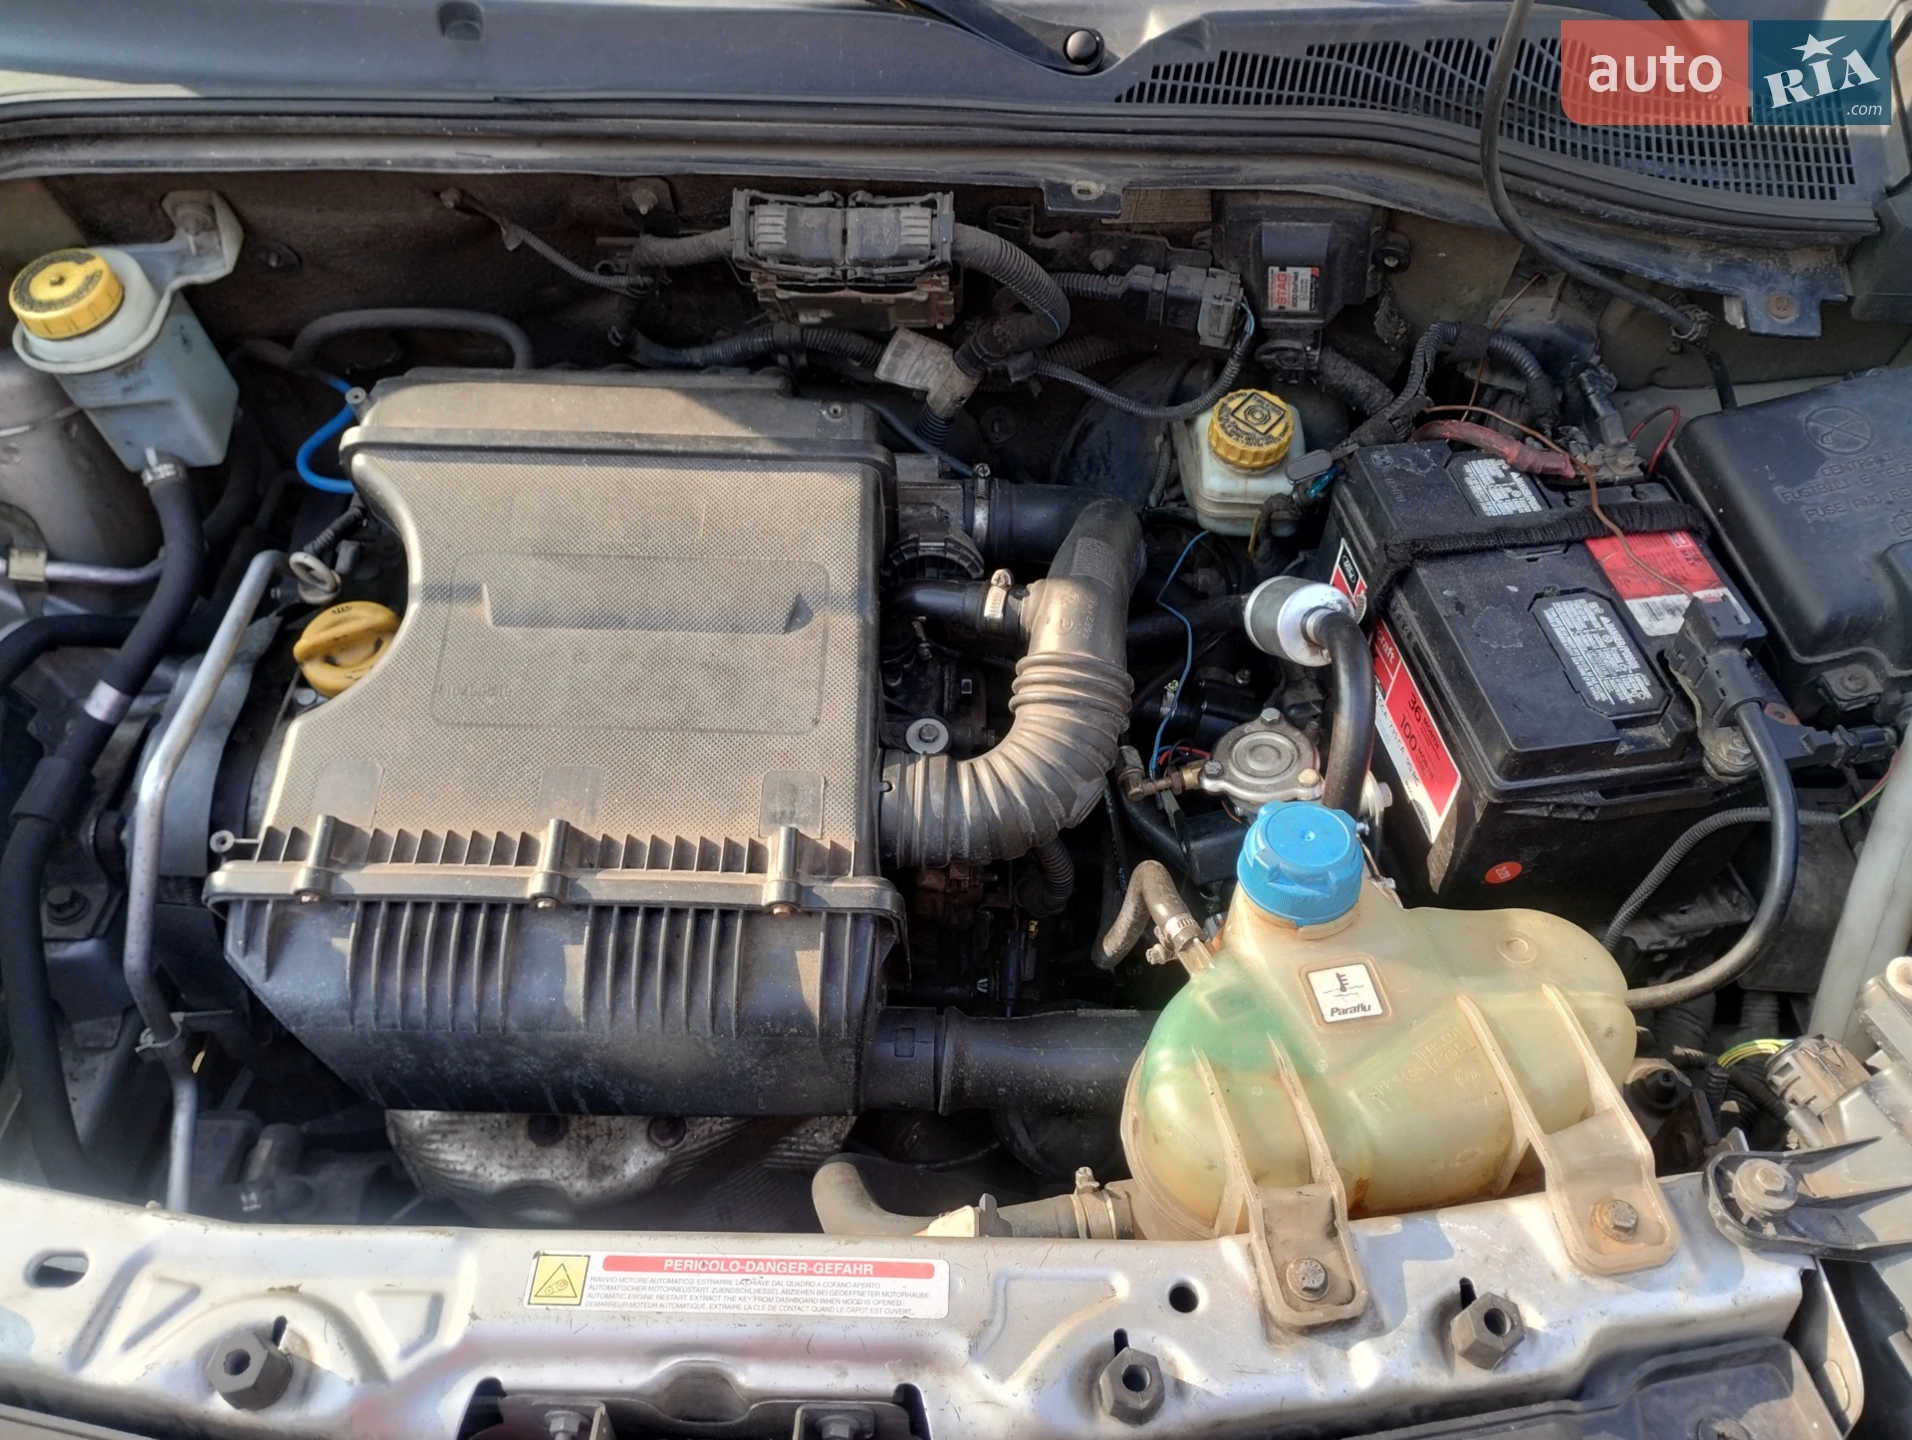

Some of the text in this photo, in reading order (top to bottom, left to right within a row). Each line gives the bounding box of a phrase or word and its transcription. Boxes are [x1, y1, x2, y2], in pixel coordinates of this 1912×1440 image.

[1277, 273, 1288, 305] STAG
[1804, 502, 1847, 519] FUSE
[1852, 494, 1882, 509] AND
[1407, 692, 1423, 723] 36
[1422, 717, 1440, 750] MONTH
[1400, 714, 1418, 752] 100
[1418, 747, 1435, 780] MONTH
[1330, 1003, 1371, 1017] Paraflu
[663, 1259, 874, 1276] PERICOLO-DANGER-GEFAHR
